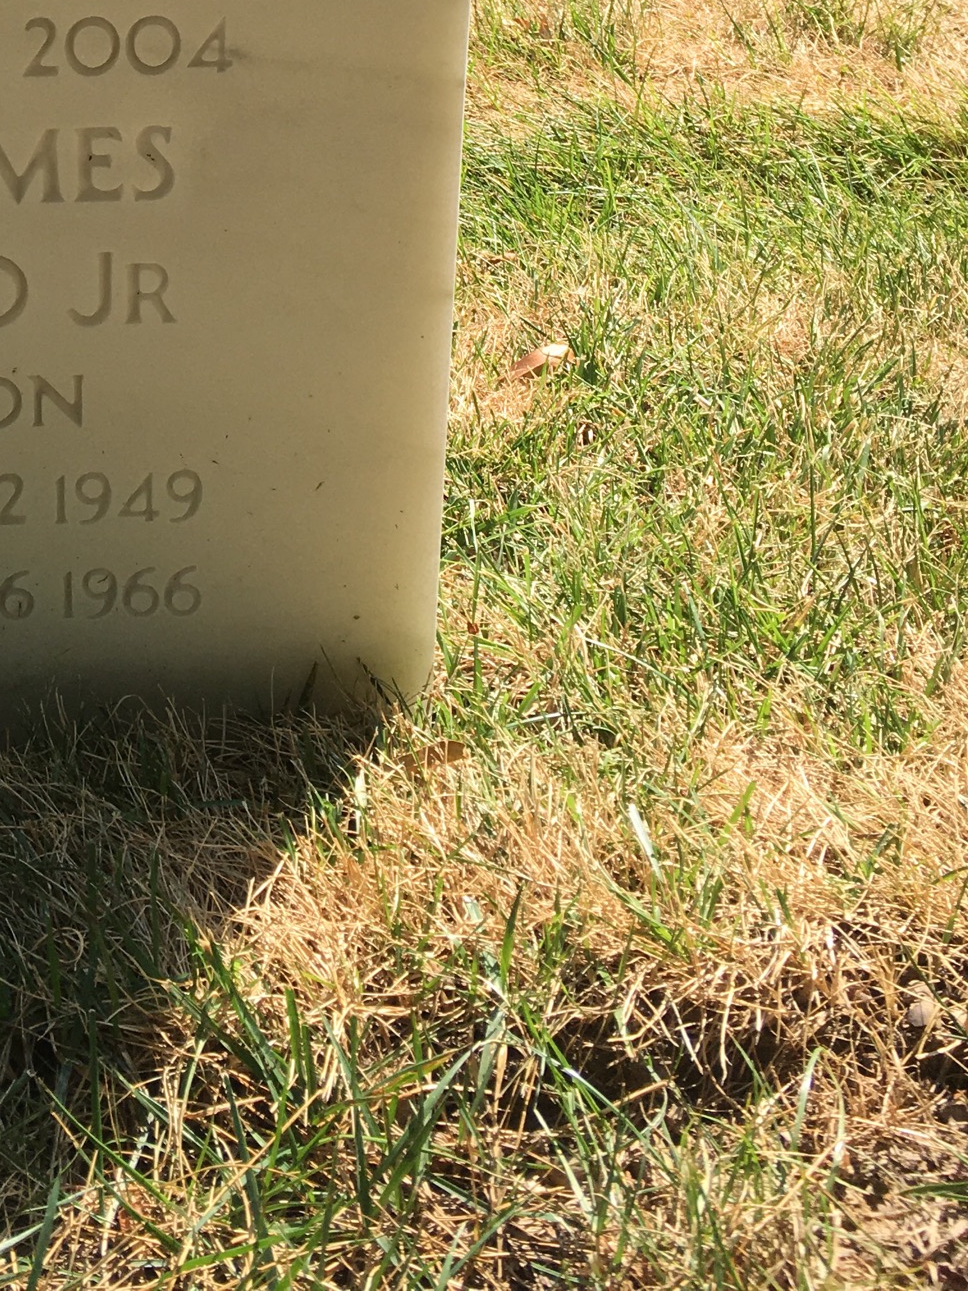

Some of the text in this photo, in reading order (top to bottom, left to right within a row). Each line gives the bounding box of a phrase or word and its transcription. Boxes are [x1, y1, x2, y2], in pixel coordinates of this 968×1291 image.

[22, 14, 234, 79] 2004
[65, 251, 178, 328] JR
[53, 468, 204, 526] 1949
[61, 564, 203, 620] 1966
